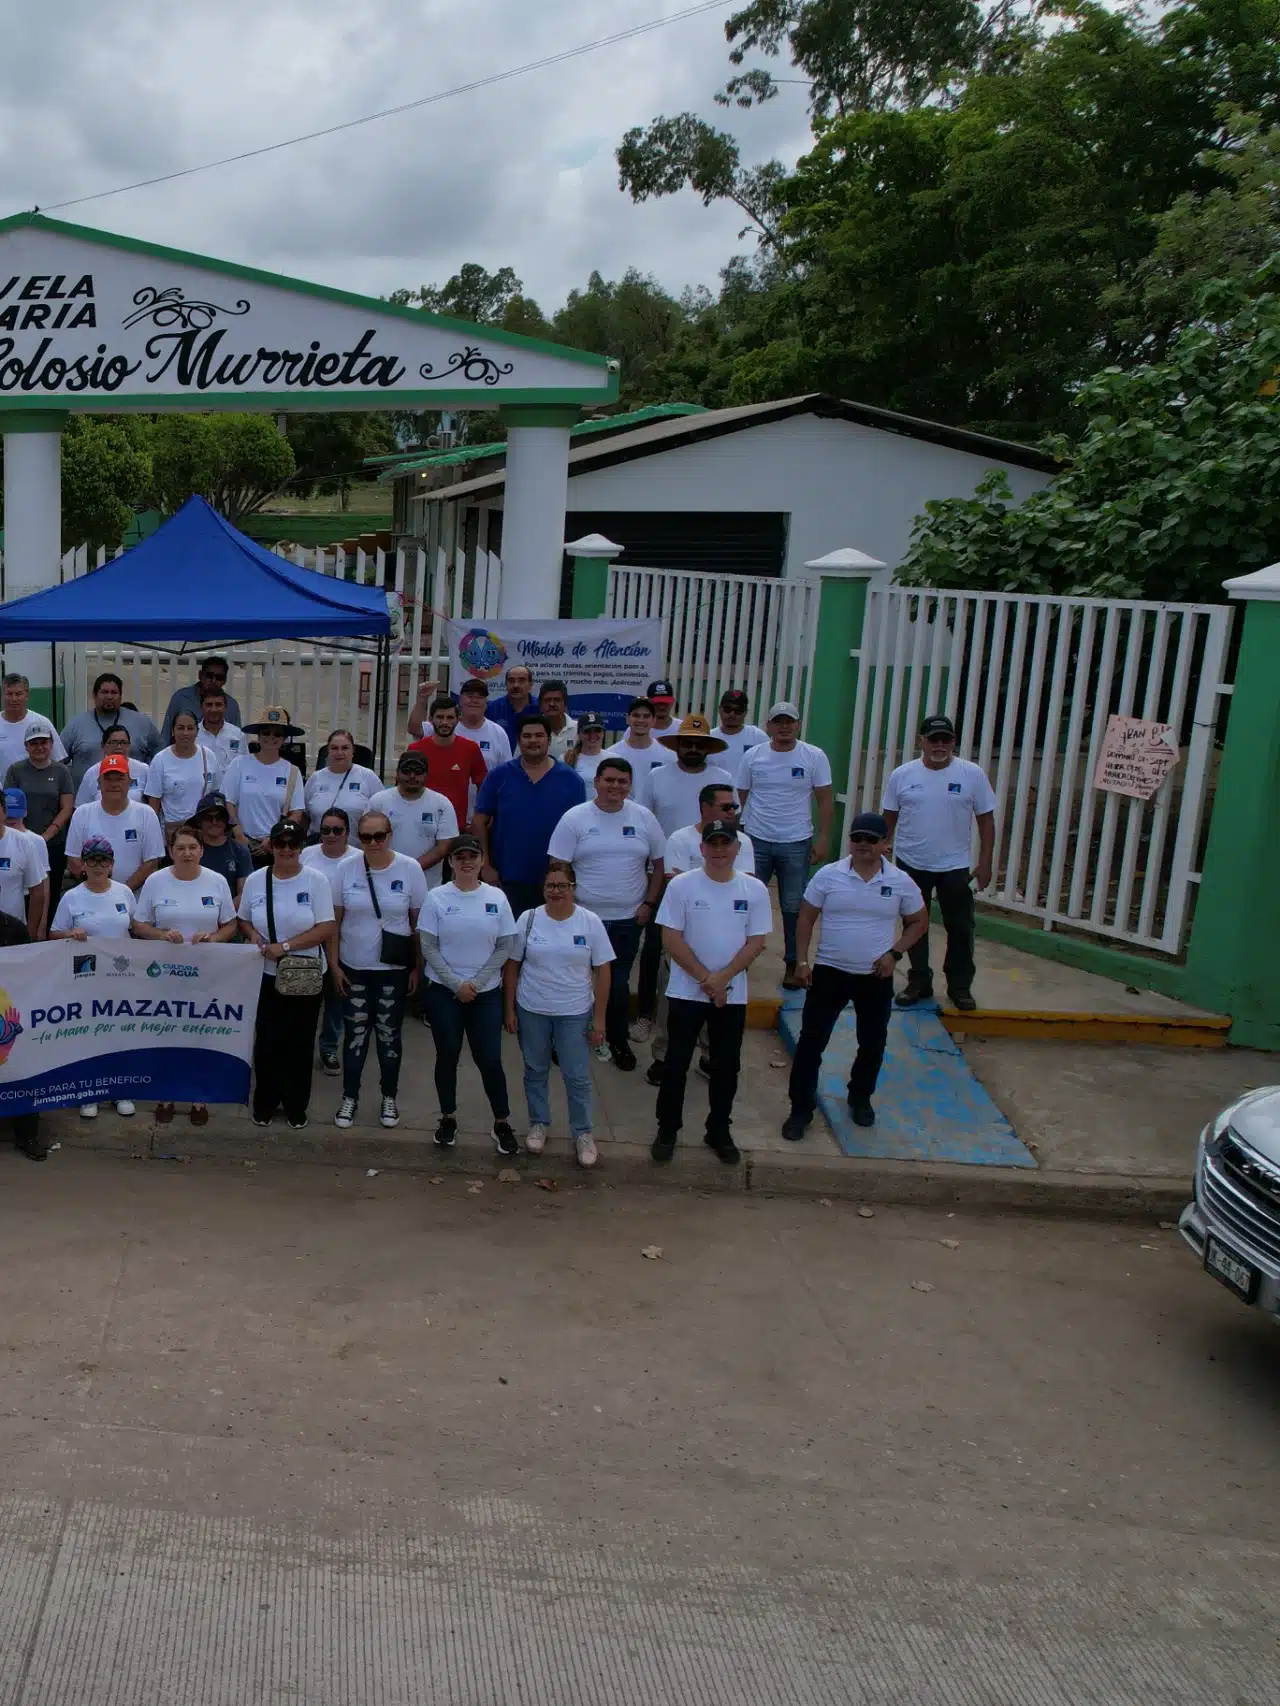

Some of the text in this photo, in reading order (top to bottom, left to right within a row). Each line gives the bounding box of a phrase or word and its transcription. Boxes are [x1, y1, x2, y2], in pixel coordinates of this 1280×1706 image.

[145, 328, 405, 389] Murrieta
[517, 639, 652, 659] Módulo de Atención
[169, 970, 199, 978] AGUA
[30, 998, 244, 1029] POR MAZATLÁN
[94, 1022, 116, 1037] por
[120, 1024, 136, 1033] un
[50, 1082, 77, 1093] PARA
[79, 1080, 93, 1088] TU
[96, 1076, 152, 1087] BENEFICIO
[33, 1089, 110, 1107] jumapam.gob.mx
